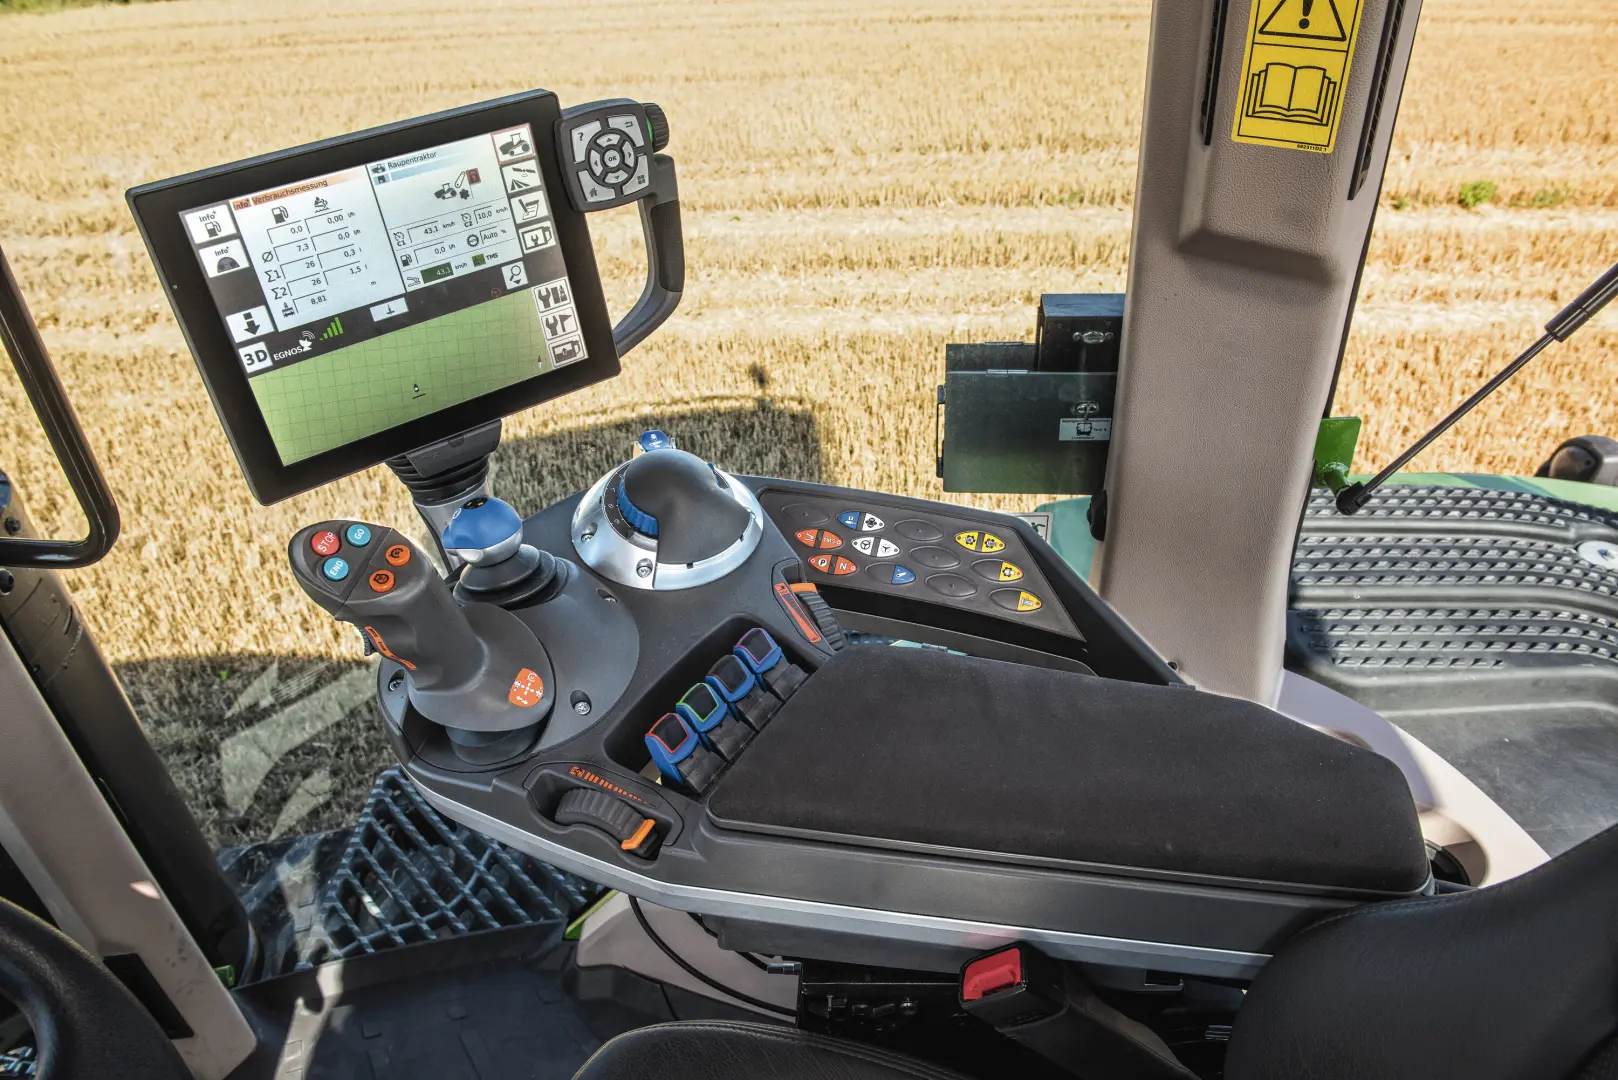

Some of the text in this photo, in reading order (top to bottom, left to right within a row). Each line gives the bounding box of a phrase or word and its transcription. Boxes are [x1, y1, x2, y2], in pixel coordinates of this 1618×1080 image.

[387, 151, 436, 169] Raupentraktor
[252, 180, 328, 204] Verbrauchsmessung
[478, 206, 508, 220] 10,0 km/h
[327, 214, 344, 224] 0,00
[290, 225, 303, 235] 0,0
[424, 221, 456, 235] 43,1 km/h
[338, 232, 350, 241] 0,0
[483, 231, 498, 240] Auto
[296, 244, 310, 252] 7,3
[434, 246, 446, 255] 0,0
[344, 249, 356, 258] 0,3
[486, 252, 498, 260] TMS
[305, 260, 316, 268] 26
[436, 262, 468, 276] 43,1 km/h
[350, 266, 362, 274] 1,5
[312, 278, 322, 286] 26
[310, 295, 327, 304] 8,81
[244, 350, 268, 366] 3D
[274, 346, 302, 360] EGNOS
[354, 528, 365, 540] GO
[318, 532, 336, 552] STOP
[330, 560, 344, 576] END
[840, 562, 848, 570] N
